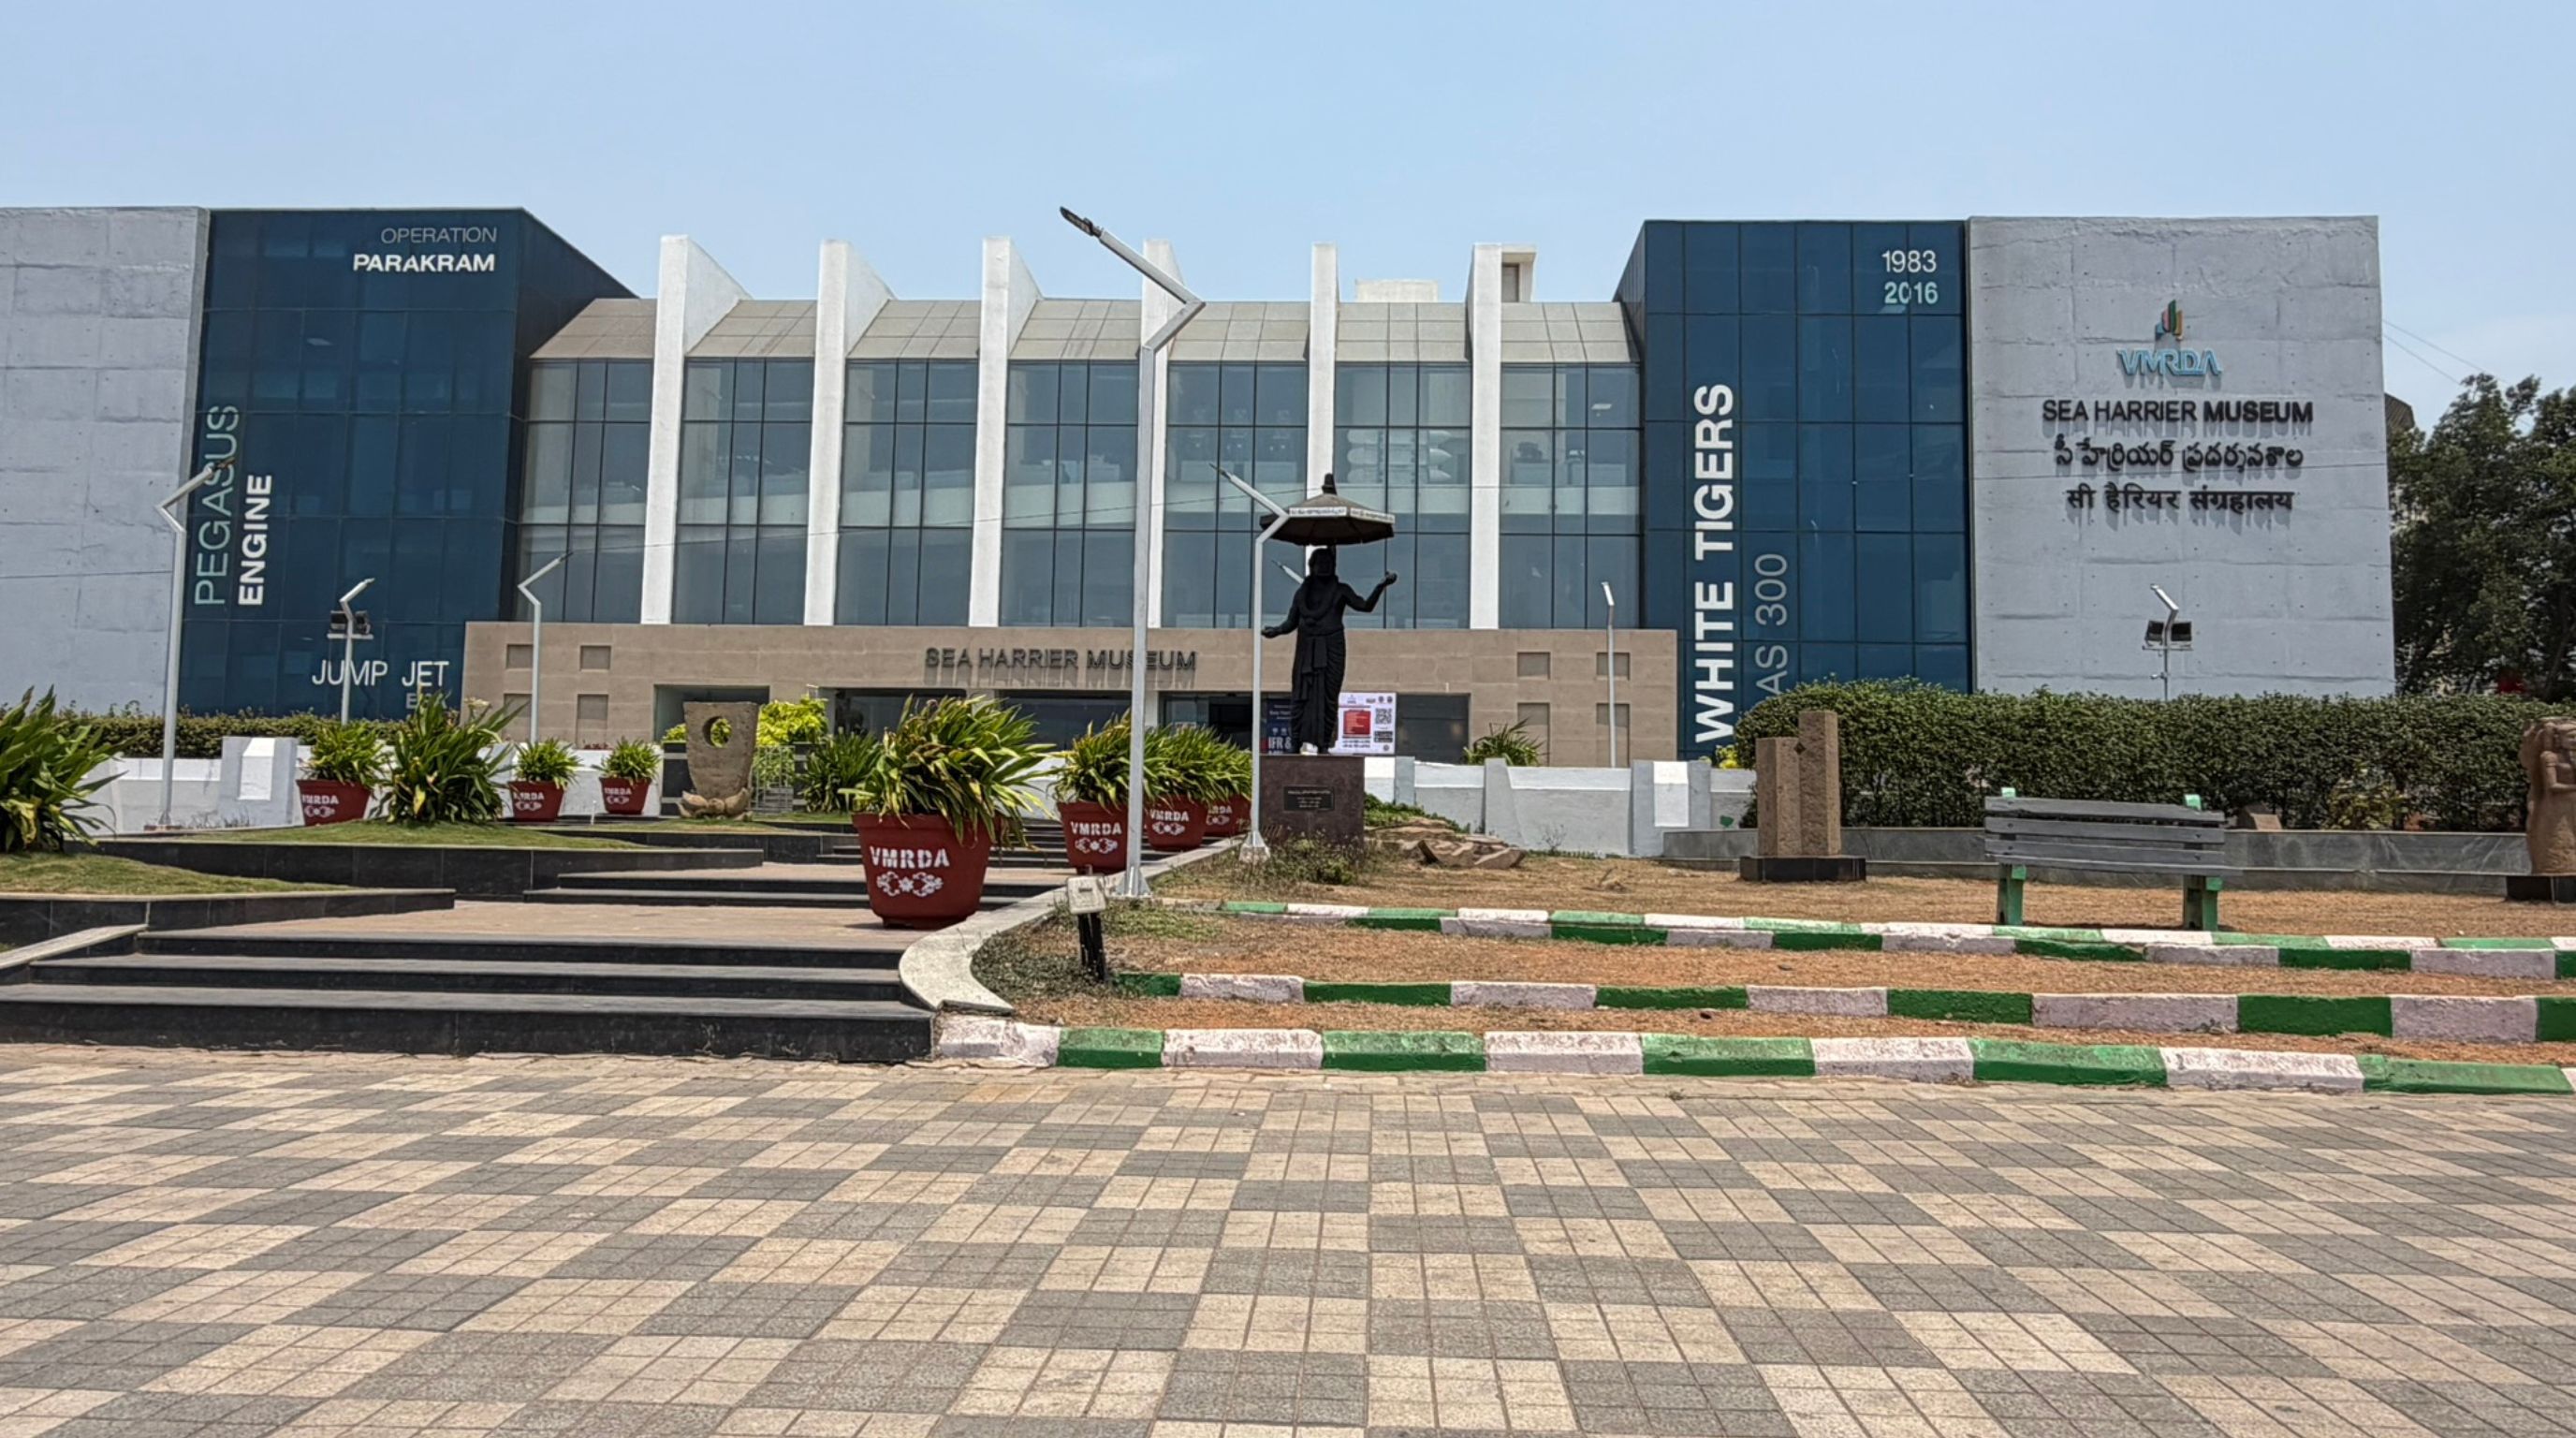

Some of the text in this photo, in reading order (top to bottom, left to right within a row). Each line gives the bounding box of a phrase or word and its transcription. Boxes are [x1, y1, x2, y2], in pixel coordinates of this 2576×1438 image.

[381, 227, 498, 244] OPERATION
[352, 253, 496, 272] PARAKRAM
[1881, 249, 1937, 273] 1983
[1884, 281, 1939, 305] 2016
[2116, 348, 2223, 376] VMRDA
[2042, 399, 2314, 423] SEA HARRIER MUSEUM
[195, 405, 240, 605] PEGASUS
[2066, 481, 2295, 515] सी हैरियर संग्रहालय
[238, 475, 272, 605] ENGINE
[1693, 384, 1734, 743] WHITE TIGERS
[1754, 553, 1787, 626] 300
[925, 647, 973, 668] SEA
[978, 648, 1078, 670] HARRIER
[311, 659, 449, 687] JUMP JET
[1071, 820, 1122, 836] VMRDA
[869, 845, 950, 869] VMRDA
